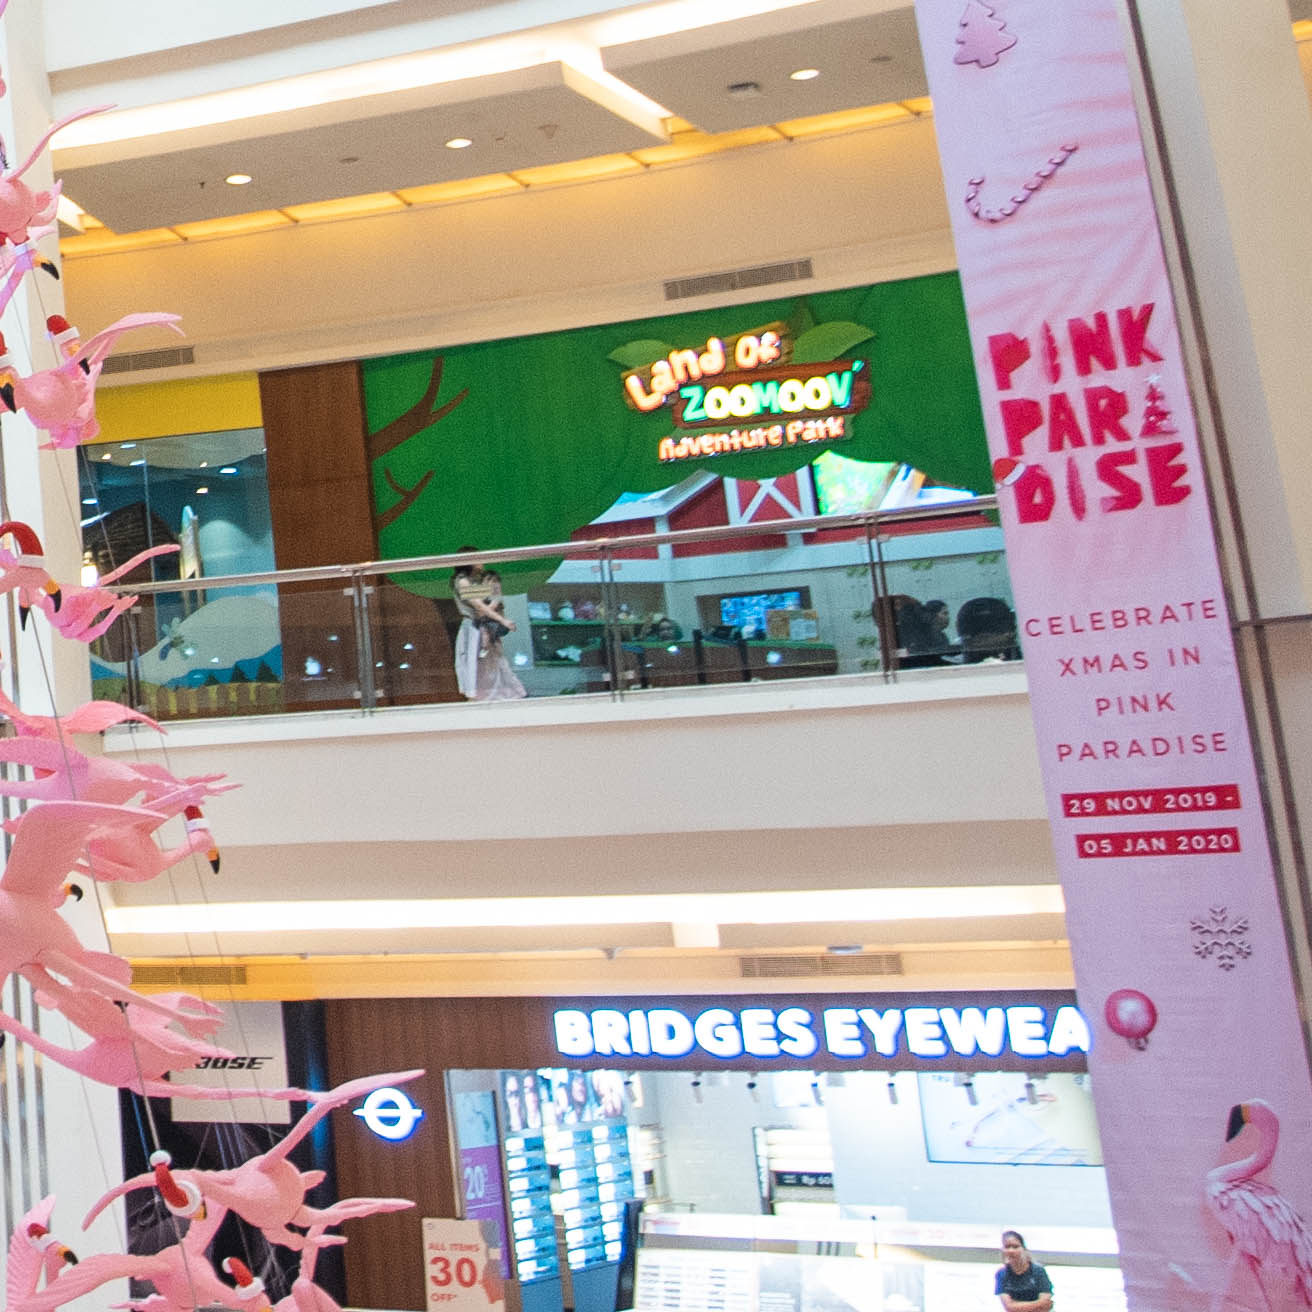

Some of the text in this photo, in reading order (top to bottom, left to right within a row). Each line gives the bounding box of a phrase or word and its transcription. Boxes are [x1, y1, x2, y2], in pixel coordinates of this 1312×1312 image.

[987, 302, 1164, 392] PINK
[1025, 599, 1218, 638] CELEBRATE
[1058, 646, 1202, 677] XMAS IN
[1095, 692, 1176, 717] PINK
[1056, 732, 1228, 763] PARADISE
[1068, 799, 1096, 814] 29
[1106, 795, 1154, 812] NOV
[1164, 791, 1218, 808] 2019
[1083, 834, 1234, 854] 05 JAN 2020
[552, 1004, 1092, 1058] BRIDGES EYEWEA
[429, 1242, 446, 1251] ALL
[430, 1256, 478, 1288] 30
